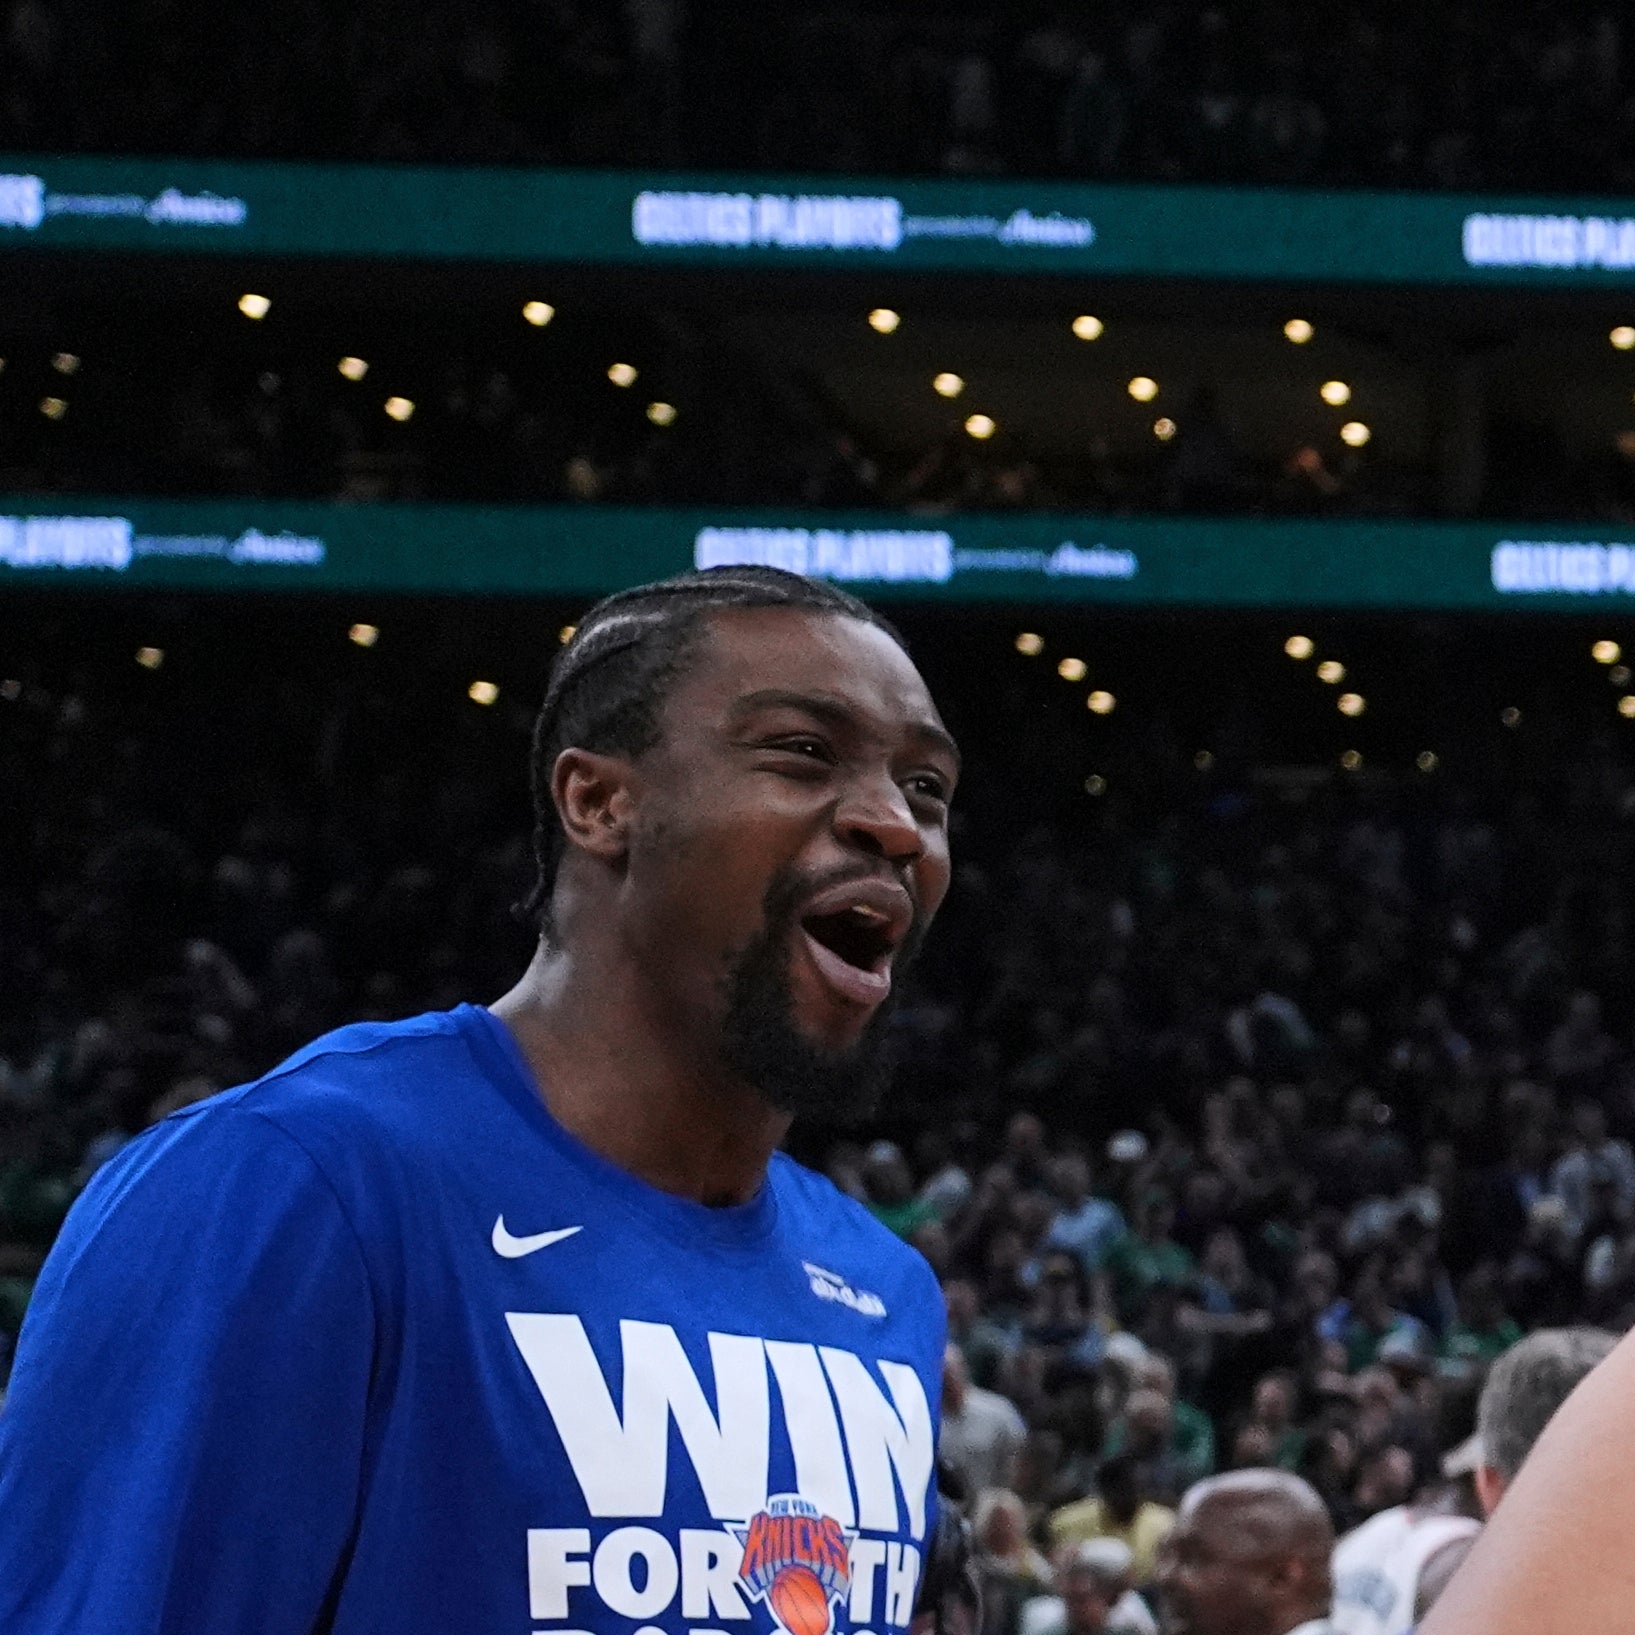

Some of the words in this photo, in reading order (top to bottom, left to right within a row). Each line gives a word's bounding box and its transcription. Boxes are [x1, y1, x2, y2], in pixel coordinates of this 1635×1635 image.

[505, 1312, 934, 1541] WIN
[527, 1526, 752, 1620] FOR
[739, 1510, 850, 1581] KNICKS
